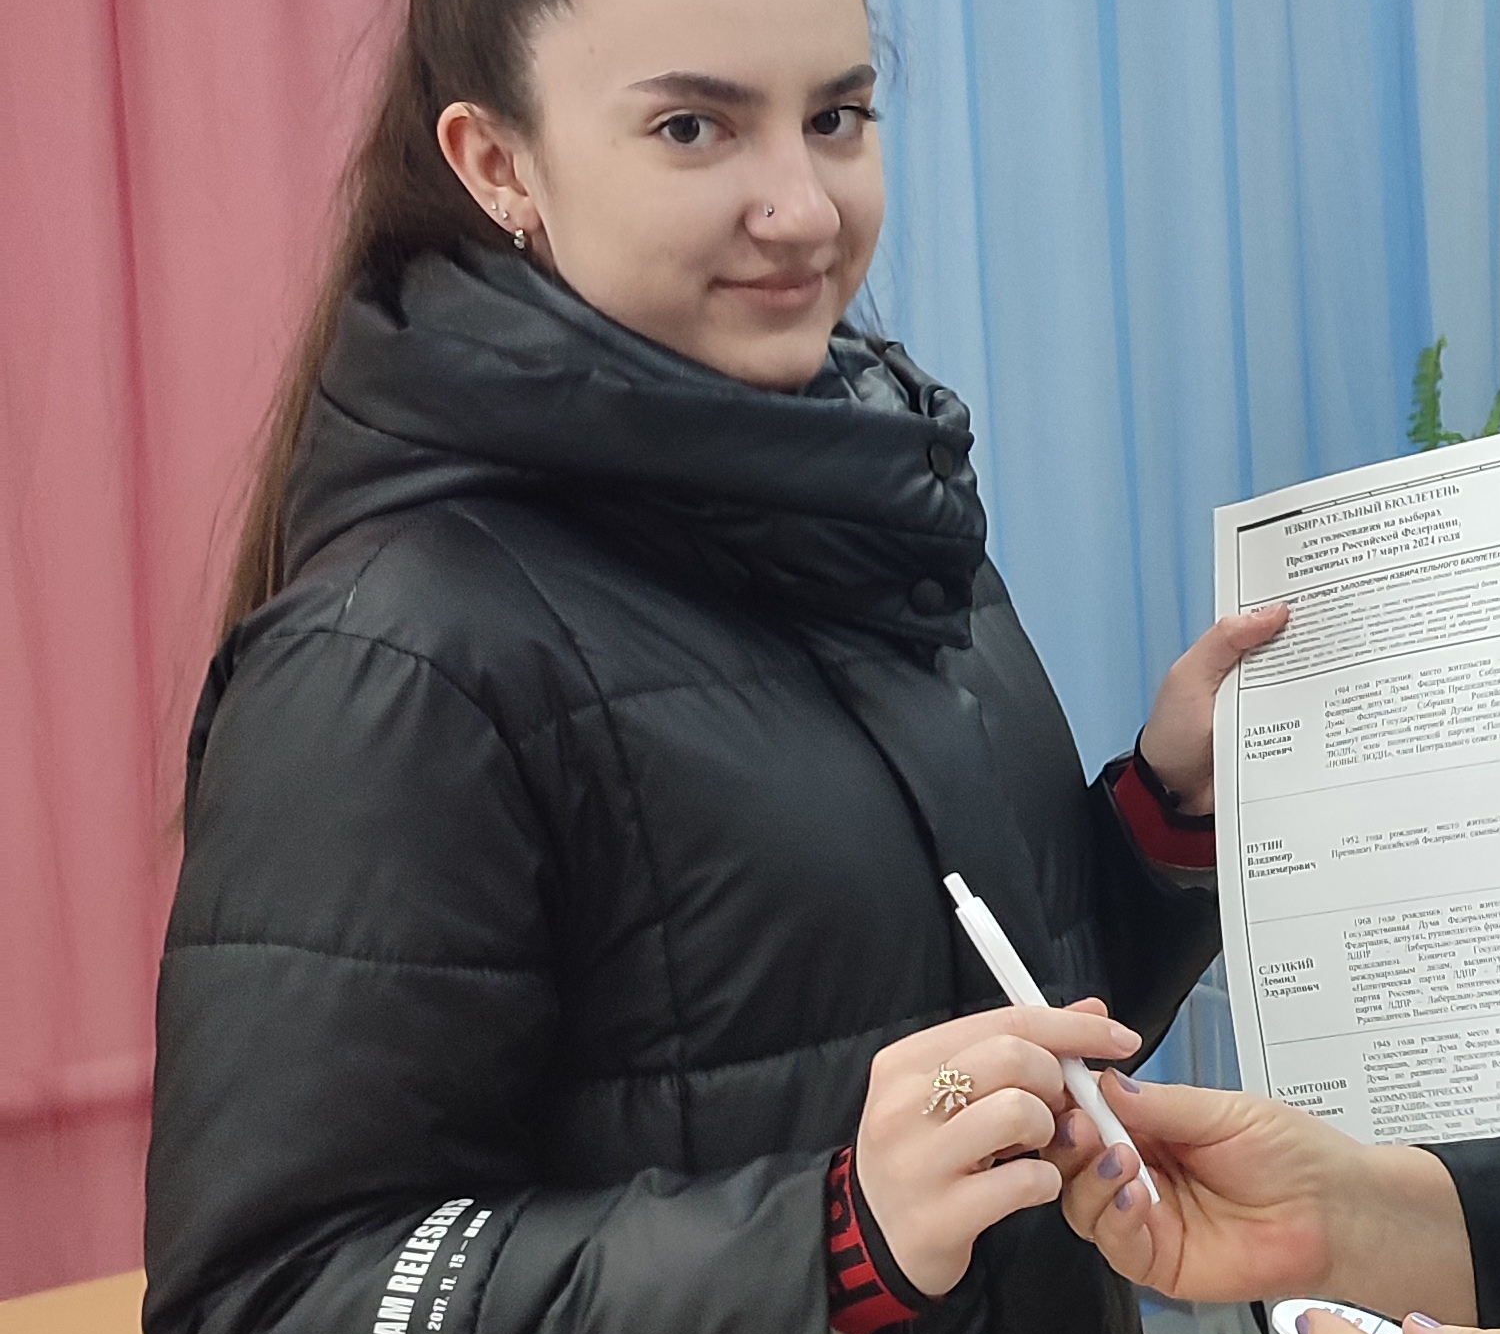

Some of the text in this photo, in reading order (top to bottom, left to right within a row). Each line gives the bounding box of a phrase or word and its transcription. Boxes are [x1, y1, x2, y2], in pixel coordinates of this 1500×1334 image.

[1284, 485, 1460, 536] ИЗБИРАТЕЛЬНЫЙ БЮЛЛЕТЕНЬ
[1320, 522, 1381, 544] голосования
[1384, 520, 1395, 528] на
[1399, 509, 1442, 526] выборах
[1286, 546, 1339, 567] Президента
[1342, 530, 1399, 553] Российской
[1288, 531, 1461, 579] назначенных на 17 марта 2024 года
[1390, 560, 1459, 581] ИЗБИРАТЕЛЬНОГО
[1244, 720, 1300, 738] ДАВАНКОВ
[1245, 735, 1291, 748] Владислав
[1245, 746, 1292, 760] Андреевич
[1247, 839, 1283, 854] ПУТИН
[1248, 852, 1292, 866] Владимир
[1249, 862, 1316, 879] Владимирович
[1258, 957, 1314, 976] СЛУЦКИЙ
[1261, 974, 1296, 986] Леонид
[1263, 982, 1320, 997] Эдуардович
[1277, 1079, 1347, 1097] ХАРИТОНОВ
[449, 1253, 466, 1268] 15
